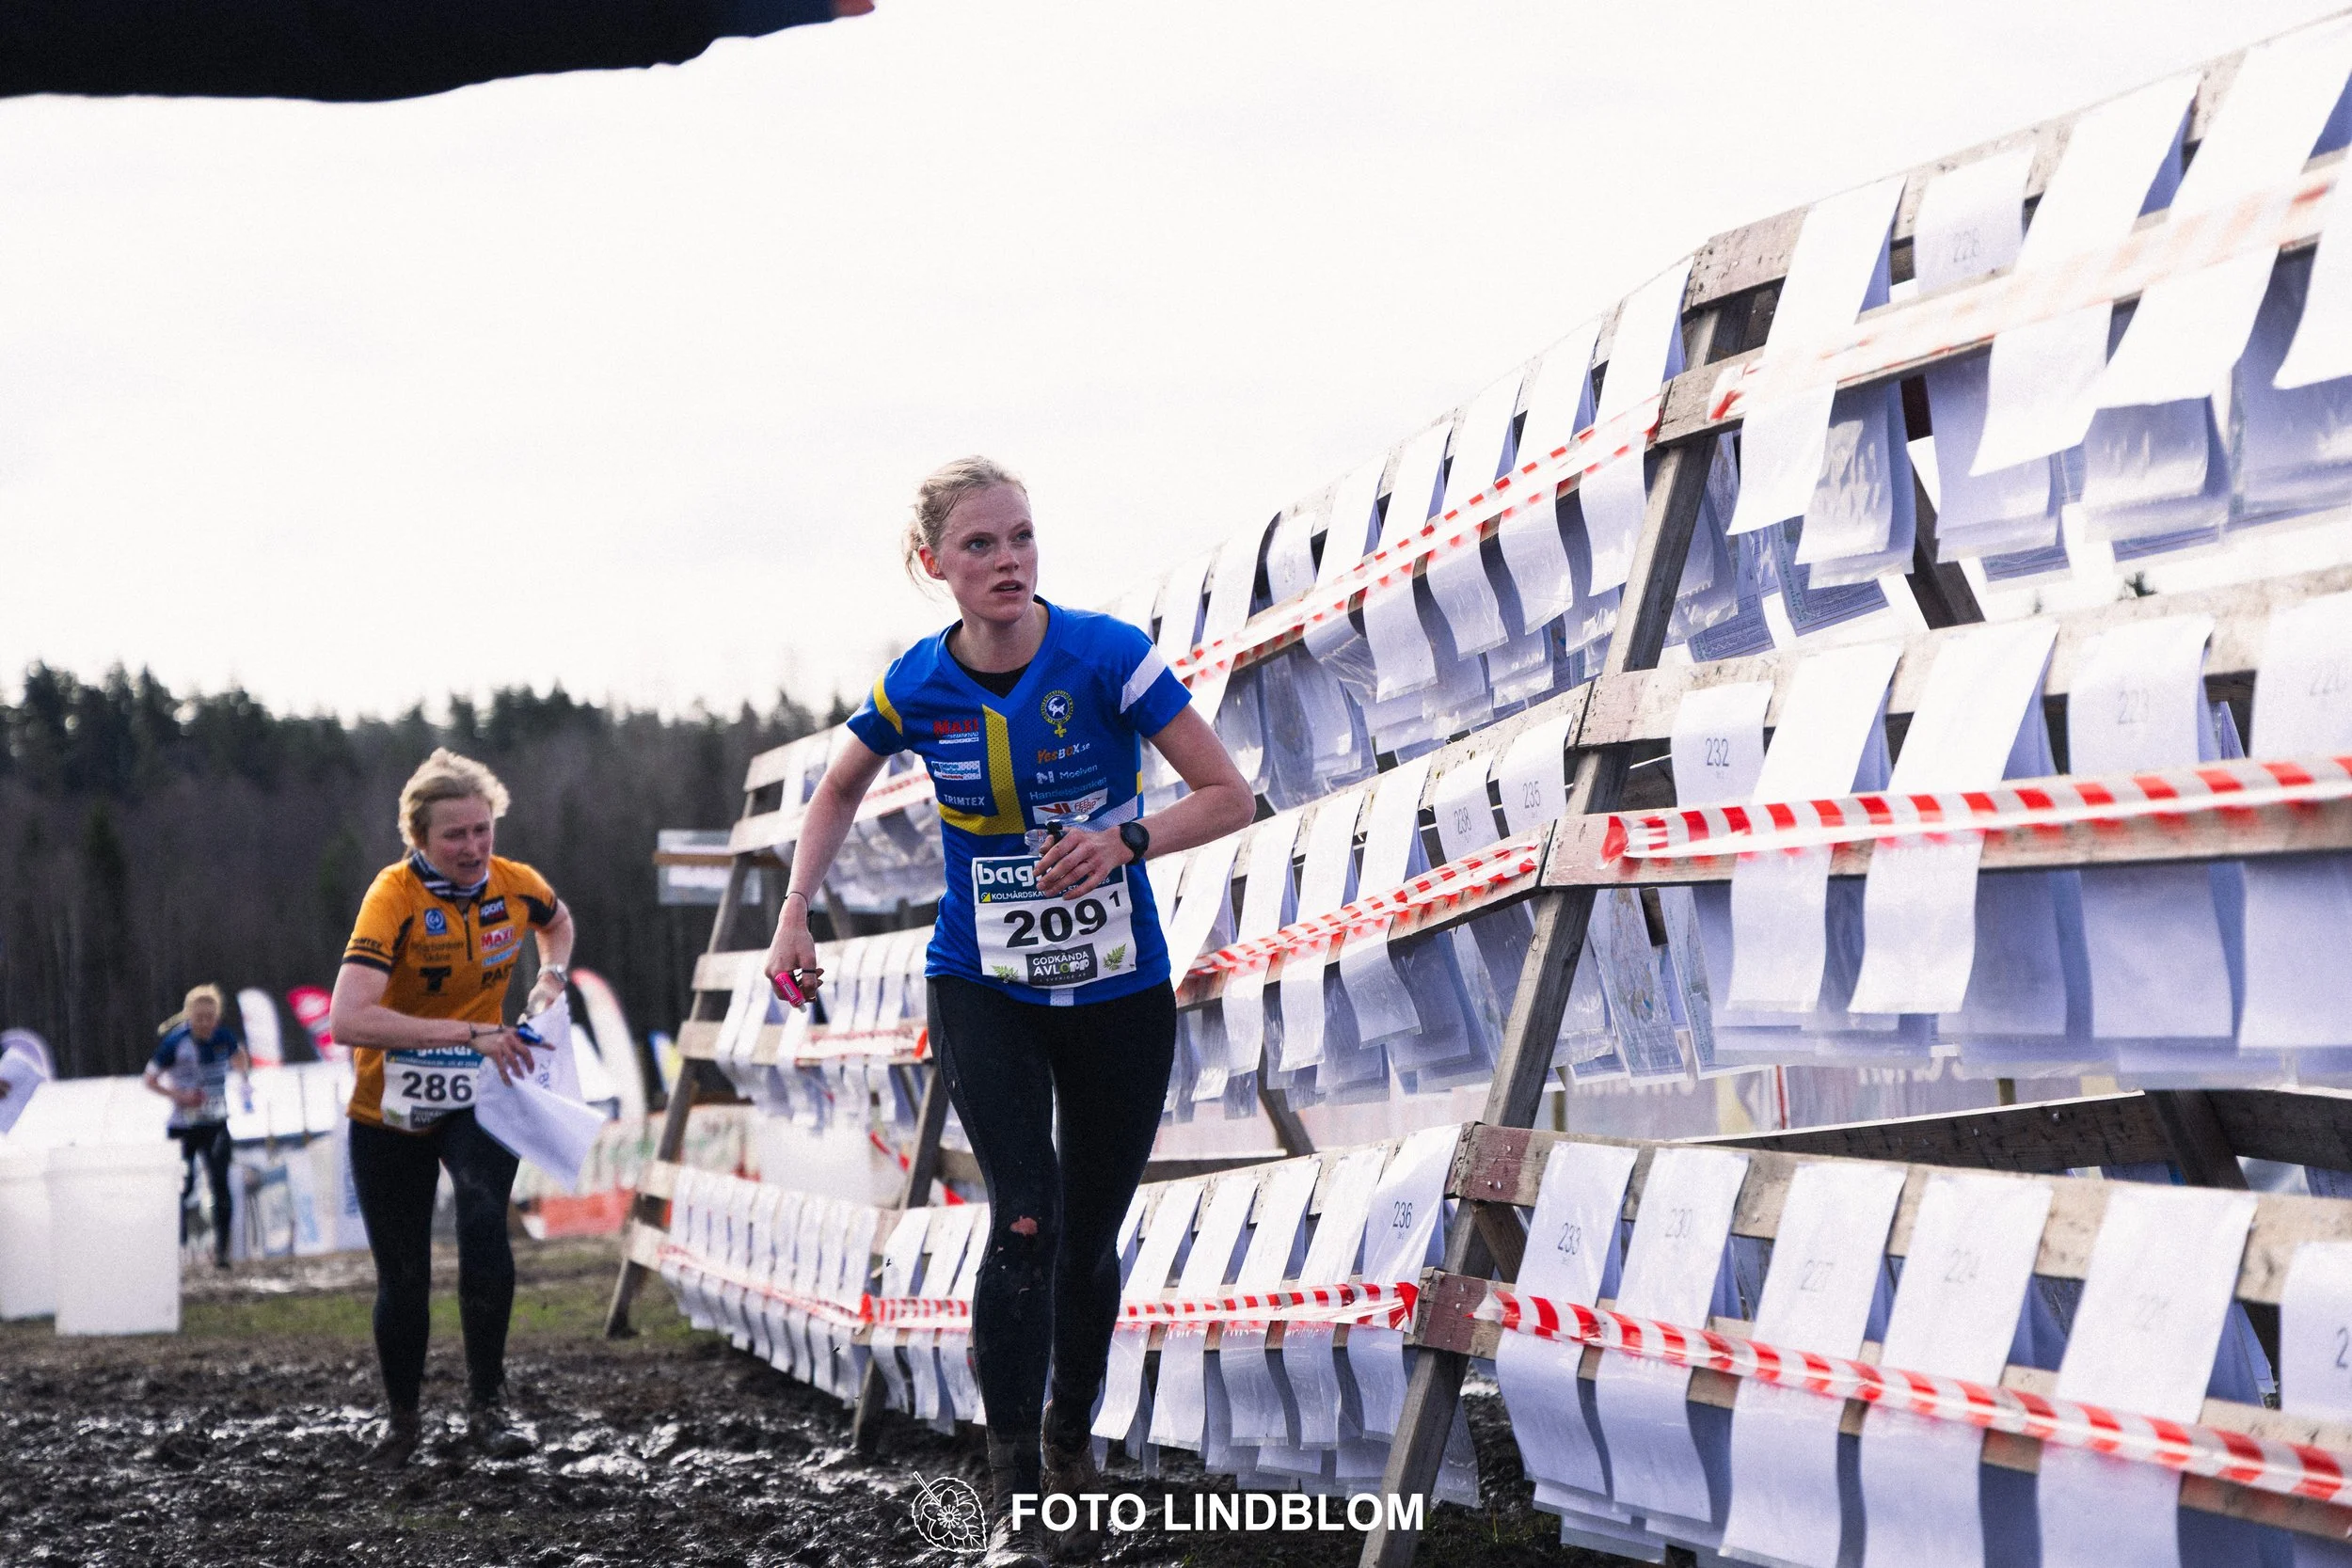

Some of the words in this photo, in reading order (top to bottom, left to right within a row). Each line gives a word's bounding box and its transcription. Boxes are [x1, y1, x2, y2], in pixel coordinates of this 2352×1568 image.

[933, 718, 978, 736] MAXI
[1706, 737, 1730, 768] 232
[1059, 765, 1098, 780] Moelven
[944, 794, 986, 806] TRIMTEX
[1029, 777, 1107, 800] Handelsbanken
[1522, 781, 1541, 809] 235
[1454, 806, 1472, 835] 238
[1003, 898, 1107, 948] 209
[1108, 891, 1120, 908] 1
[481, 928, 513, 947] MAXI
[1032, 951, 1089, 966] GODKÄNDA
[402, 1070, 472, 1101] 286
[1392, 1200, 1413, 1229] 236
[1665, 1208, 1692, 1239] 230
[1557, 1222, 1581, 1256] 233
[1800, 1259, 1835, 1292] 227
